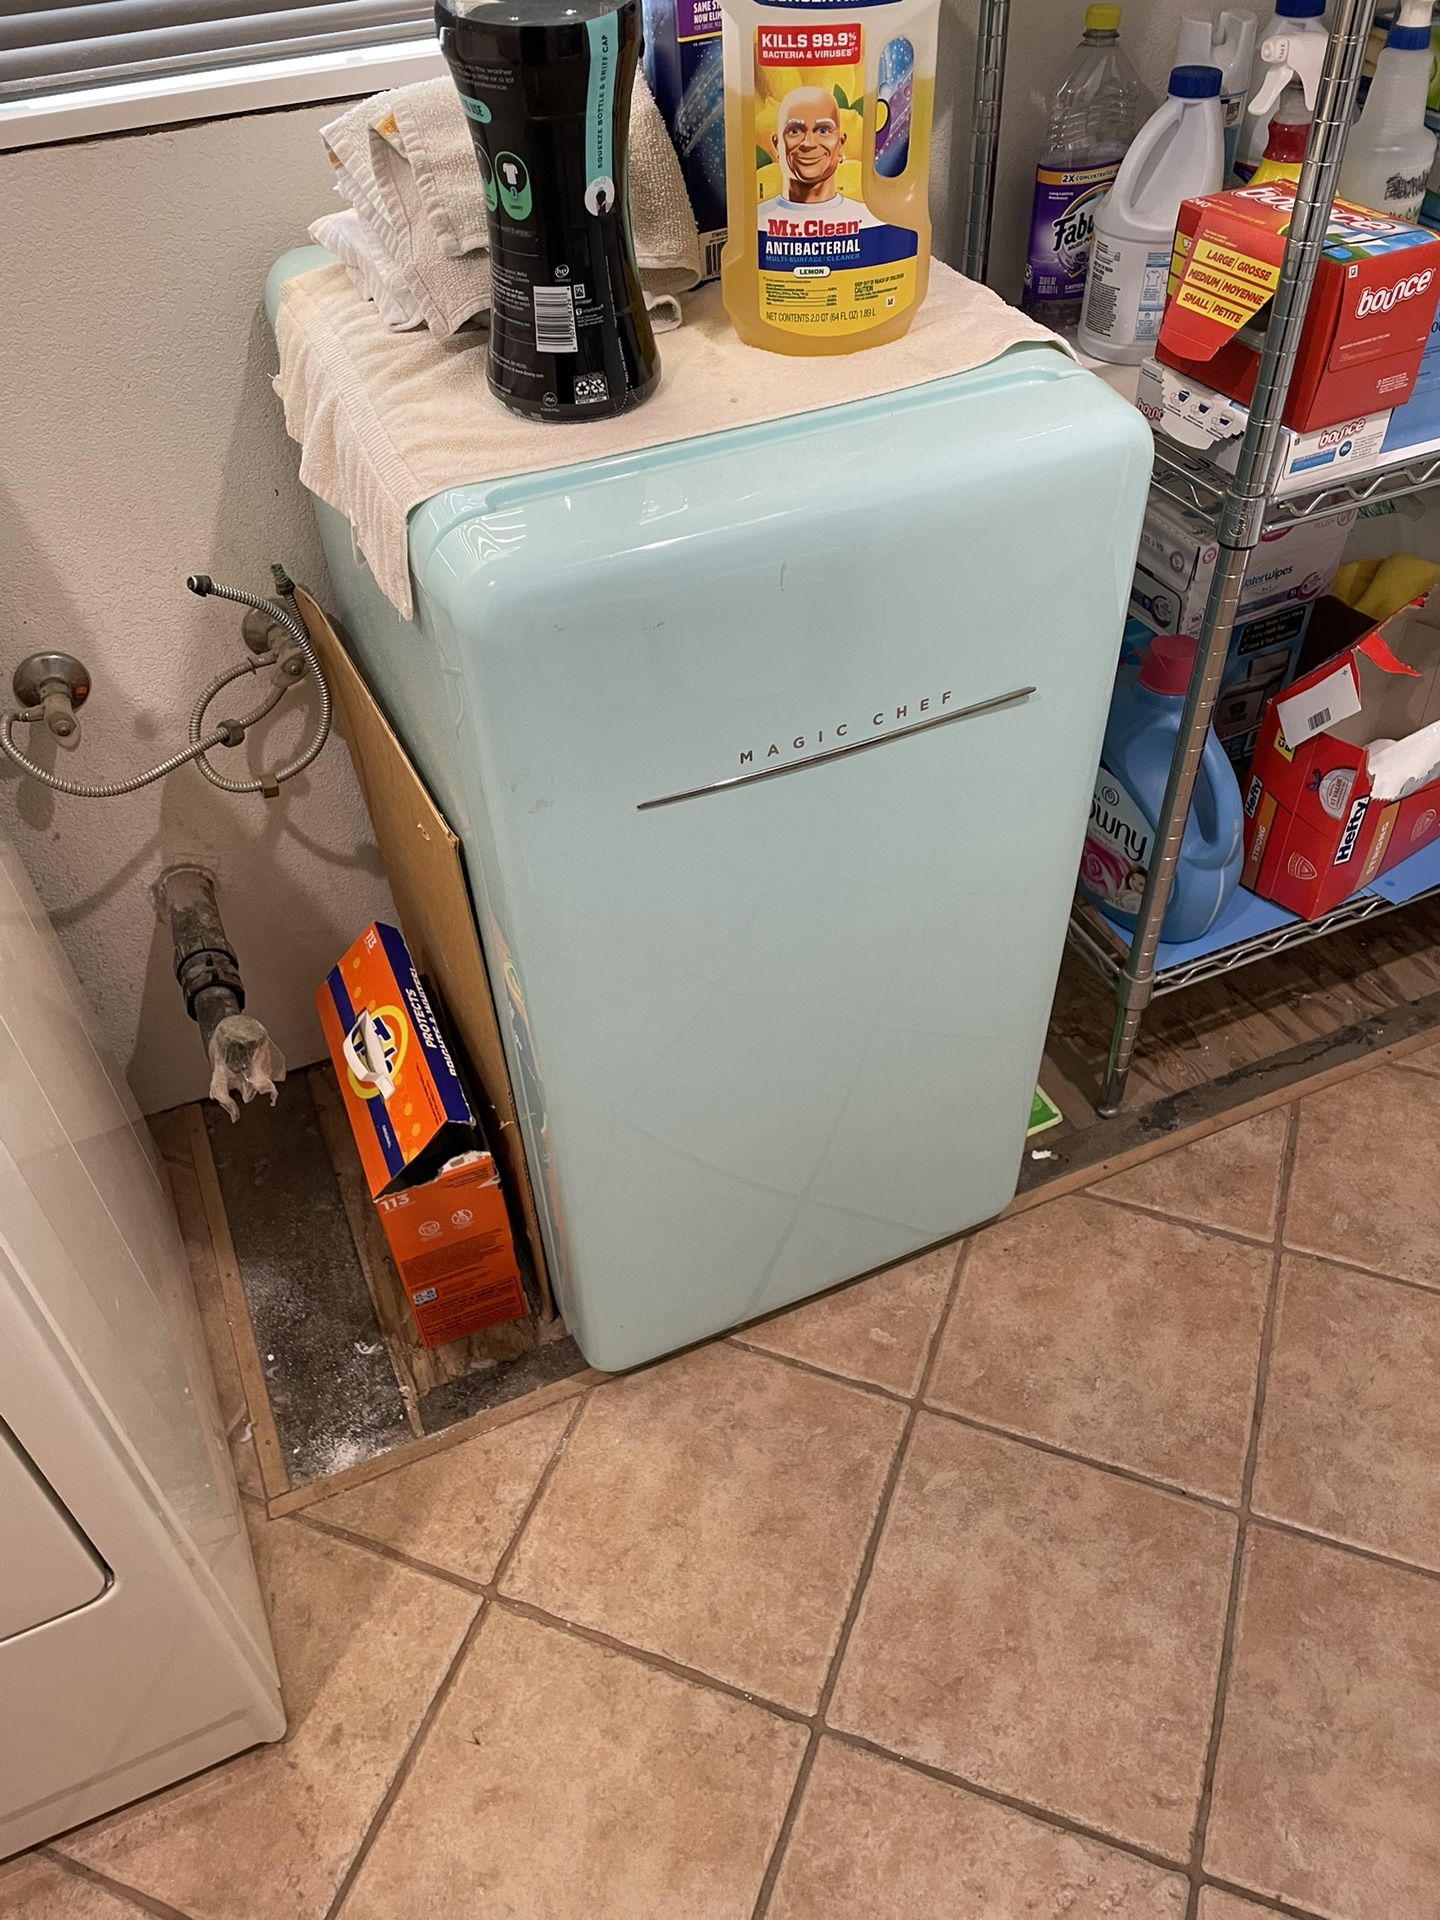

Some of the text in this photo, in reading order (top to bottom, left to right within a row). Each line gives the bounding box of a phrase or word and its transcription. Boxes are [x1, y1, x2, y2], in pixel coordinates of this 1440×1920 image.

[694, 1, 711, 14] SAME
[694, 14, 708, 24] NOW
[601, 34, 609, 53] CAP
[761, 34, 808, 48] KILLS
[762, 49, 852, 59] BACTERIA & VIRUSES
[600, 57, 608, 81] SNIFF
[597, 93, 605, 126] BOTTLE
[1062, 174, 1075, 183] 2X
[767, 219, 860, 237] Mr.Clean
[765, 238, 861, 256] ANTIBACTERIAL
[765, 253, 860, 263] MULTI-SURFACE CLEANER
[1206, 250, 1272, 281] LARGE GROSSE
[1188, 268, 1265, 306] MEDIUM MOYENNE
[1355, 269, 1433, 318] bounce
[766, 312, 777, 321] NET
[778, 312, 809, 322] CONTENTS
[810, 313, 820, 322] 2.0
[830, 311, 840, 322] (64
[840, 311, 847, 320] FL
[848, 310, 858, 320] OZ)
[860, 308, 871, 319] 1.89
[1182, 292, 1243, 323] SMALL PETITE
[1318, 418, 1366, 449] bounce
[739, 690, 952, 764] MAGIC CHEF
[1246, 779, 1263, 814] Hefty
[1336, 800, 1367, 861] Hefty
[1252, 825, 1266, 862] STRONG
[1366, 821, 1390, 876] STRONG
[366, 930, 378, 949] 113
[405, 988, 438, 1049] PROTECTS
[380, 1193, 410, 1210] 113
